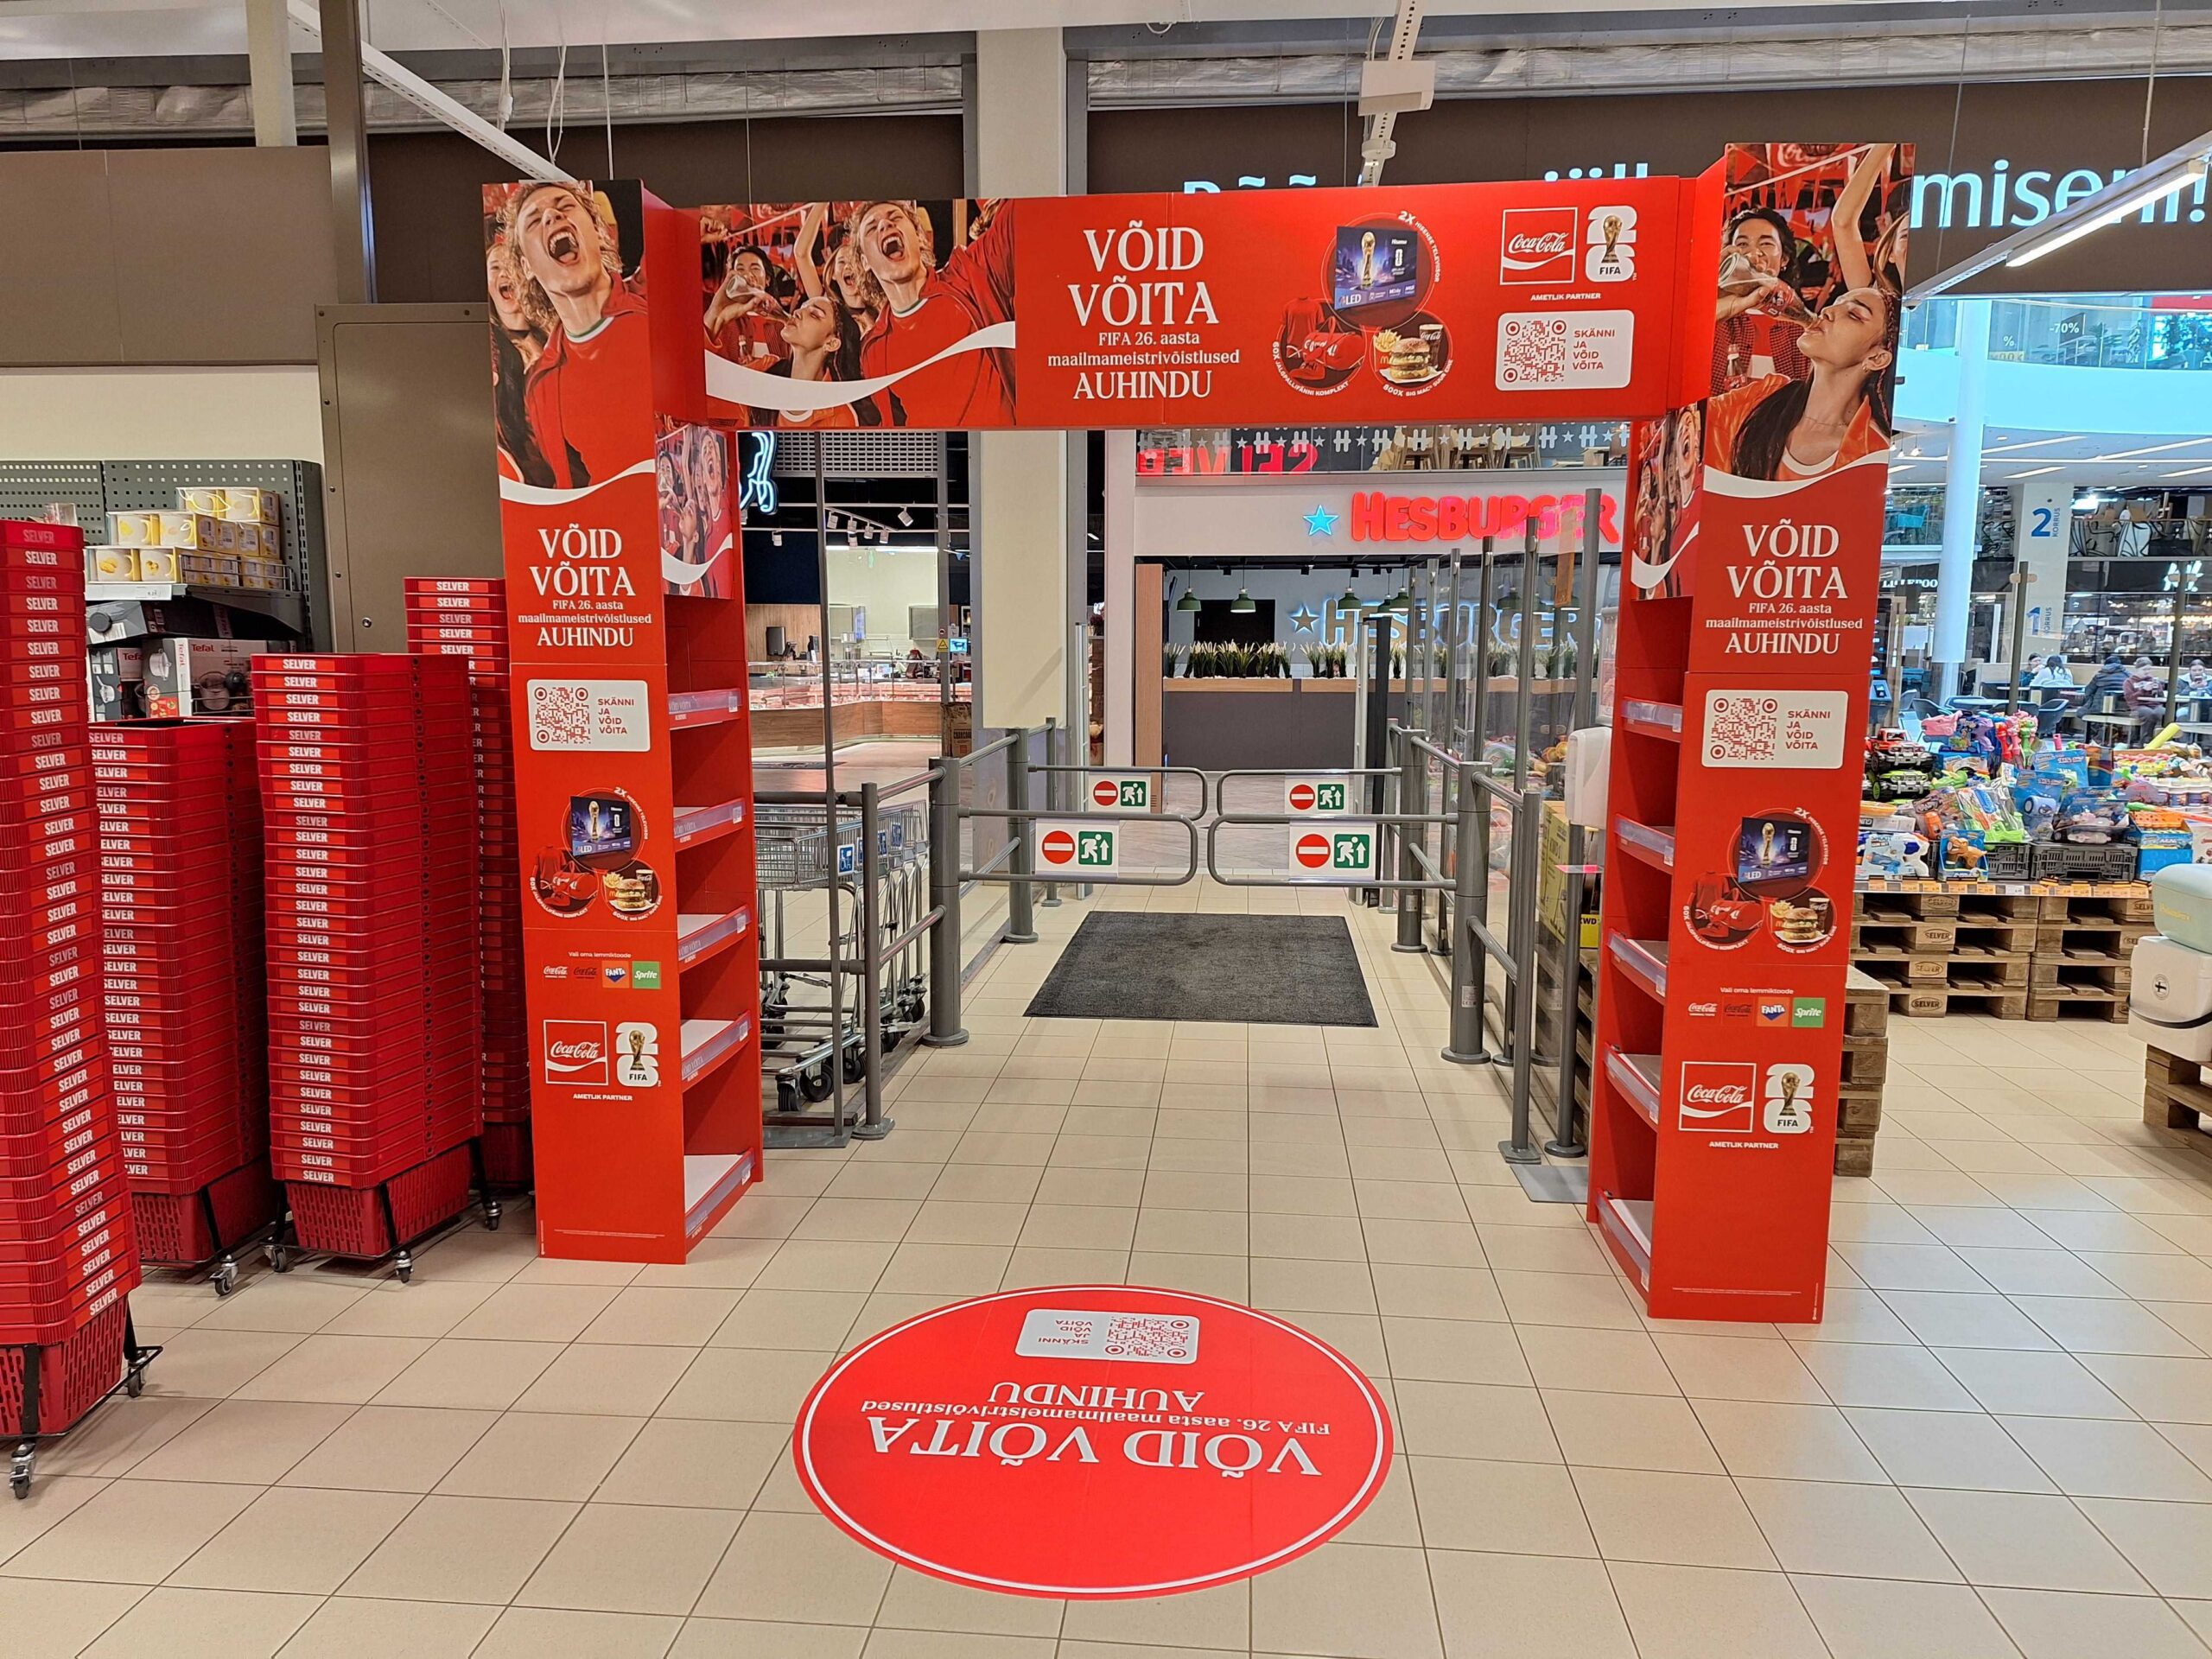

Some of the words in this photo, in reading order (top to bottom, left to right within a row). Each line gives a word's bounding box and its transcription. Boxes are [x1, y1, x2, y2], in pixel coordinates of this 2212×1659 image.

[1397, 210, 1416, 225] 2X
[1083, 219, 1205, 272] VÕID
[1508, 232, 1569, 254] Coca-Cola
[1599, 266, 1621, 276] FIFA
[1067, 275, 1220, 327] VÕITA
[1530, 293, 1565, 302] AMETLIK
[1565, 292, 1602, 301] PARTNER
[1573, 327, 1616, 338] SKÄNNI
[1098, 332, 1132, 346] FIFA
[1135, 332, 1157, 346] 26.
[1160, 333, 1200, 345] aasta
[1573, 340, 1587, 349] JA
[1047, 349, 1240, 366] maailmameistrivõistlused
[1573, 349, 1599, 359] VÕID
[1572, 360, 1605, 371] VÕITA
[1073, 370, 1212, 399] AUHINDU
[1315, 381, 1349, 397] KOMPLEKT
[2031, 508, 2052, 537] 2
[537, 523, 623, 559] VÕID
[1742, 518, 1840, 557] VÕID
[529, 561, 636, 596] VÕITA
[1726, 560, 1848, 599] VÕITA
[435, 581, 470, 592] SELVER
[26, 597, 59, 610] SELVER
[436, 597, 471, 607] SELVER
[552, 600, 576, 610] FIFA
[577, 600, 594, 610] 26.
[595, 601, 624, 610] aasta
[1748, 603, 1776, 614] FIFA
[1778, 602, 1797, 614] 26.
[1799, 604, 1832, 614] aasta
[439, 613, 472, 624] SELVER
[518, 613, 652, 624] maailmameistrivõistlused
[1706, 617, 1863, 629] maailmameistrivõistlused
[2026, 607, 2041, 635] 1
[439, 628, 473, 639] SELVER
[537, 627, 634, 647] AUHINDU
[191, 644, 215, 652] Tefal
[1724, 632, 1841, 655] AUHINDU
[441, 645, 474, 655] SELVER
[123, 652, 143, 661] Tefa
[283, 658, 316, 671] SELVER
[29, 664, 60, 678] SELVER
[285, 694, 320, 705] SELVER
[1787, 709, 1831, 719] SKÄNNI
[598, 716, 622, 725] VÕID
[1786, 720, 1802, 729] JA
[289, 729, 321, 741] SELVER
[599, 725, 628, 734] VÕITA
[1786, 730, 1814, 740] VÕID
[87, 733, 124, 743] SELVER
[1785, 740, 1819, 750] VÕITA
[92, 749, 127, 760] SELVER
[35, 753, 67, 769] SELVER
[289, 763, 322, 775] SELVER
[293, 797, 327, 809] SELVER
[1794, 806, 1810, 819] 2X
[44, 817, 74, 836] SELVER
[296, 831, 328, 842] SELVER
[296, 867, 328, 879] SELVER
[47, 880, 77, 900] SELVER
[296, 899, 328, 912] SELVER
[296, 933, 329, 945] SELVER
[1925, 931, 1950, 940] SELVER
[49, 950, 78, 963] SELVER
[297, 969, 330, 981] SELVER
[605, 968, 626, 976] FANTA
[634, 970, 658, 980] Sprite
[104, 978, 137, 990] SELVER
[104, 995, 140, 1007] SELVER
[1915, 1000, 1940, 1008] SELVER
[298, 1001, 331, 1014] SELVER
[1761, 1005, 1785, 1014] FANTA
[1795, 1007, 1822, 1018] Sprite
[50, 1007, 80, 1029] SELVER
[105, 1013, 140, 1024] SELVER
[300, 1036, 332, 1048] SELVER
[550, 1039, 601, 1059] Coca-Cola
[58, 1069, 88, 1093] SELVER
[299, 1070, 332, 1083] SELVER
[1687, 1084, 1748, 1104] Coca-Cola
[300, 1103, 332, 1116] SELVER
[63, 1129, 93, 1154] SELVER
[302, 1137, 334, 1149] SELVER
[302, 1170, 334, 1183] SELVER
[75, 1191, 103, 1217] SELVER
[82, 1249, 111, 1276] SELVER
[987, 1382, 1205, 1413] AUHINDU
[861, 1400, 1161, 1424] maailmameistrivõistlused
[1171, 1415, 1230, 1428] aasta
[1236, 1418, 1271, 1433] 26.
[1277, 1420, 1331, 1435] FIFA
[867, 1416, 1100, 1466] VÕITA
[1123, 1429, 1322, 1478] VÕID
